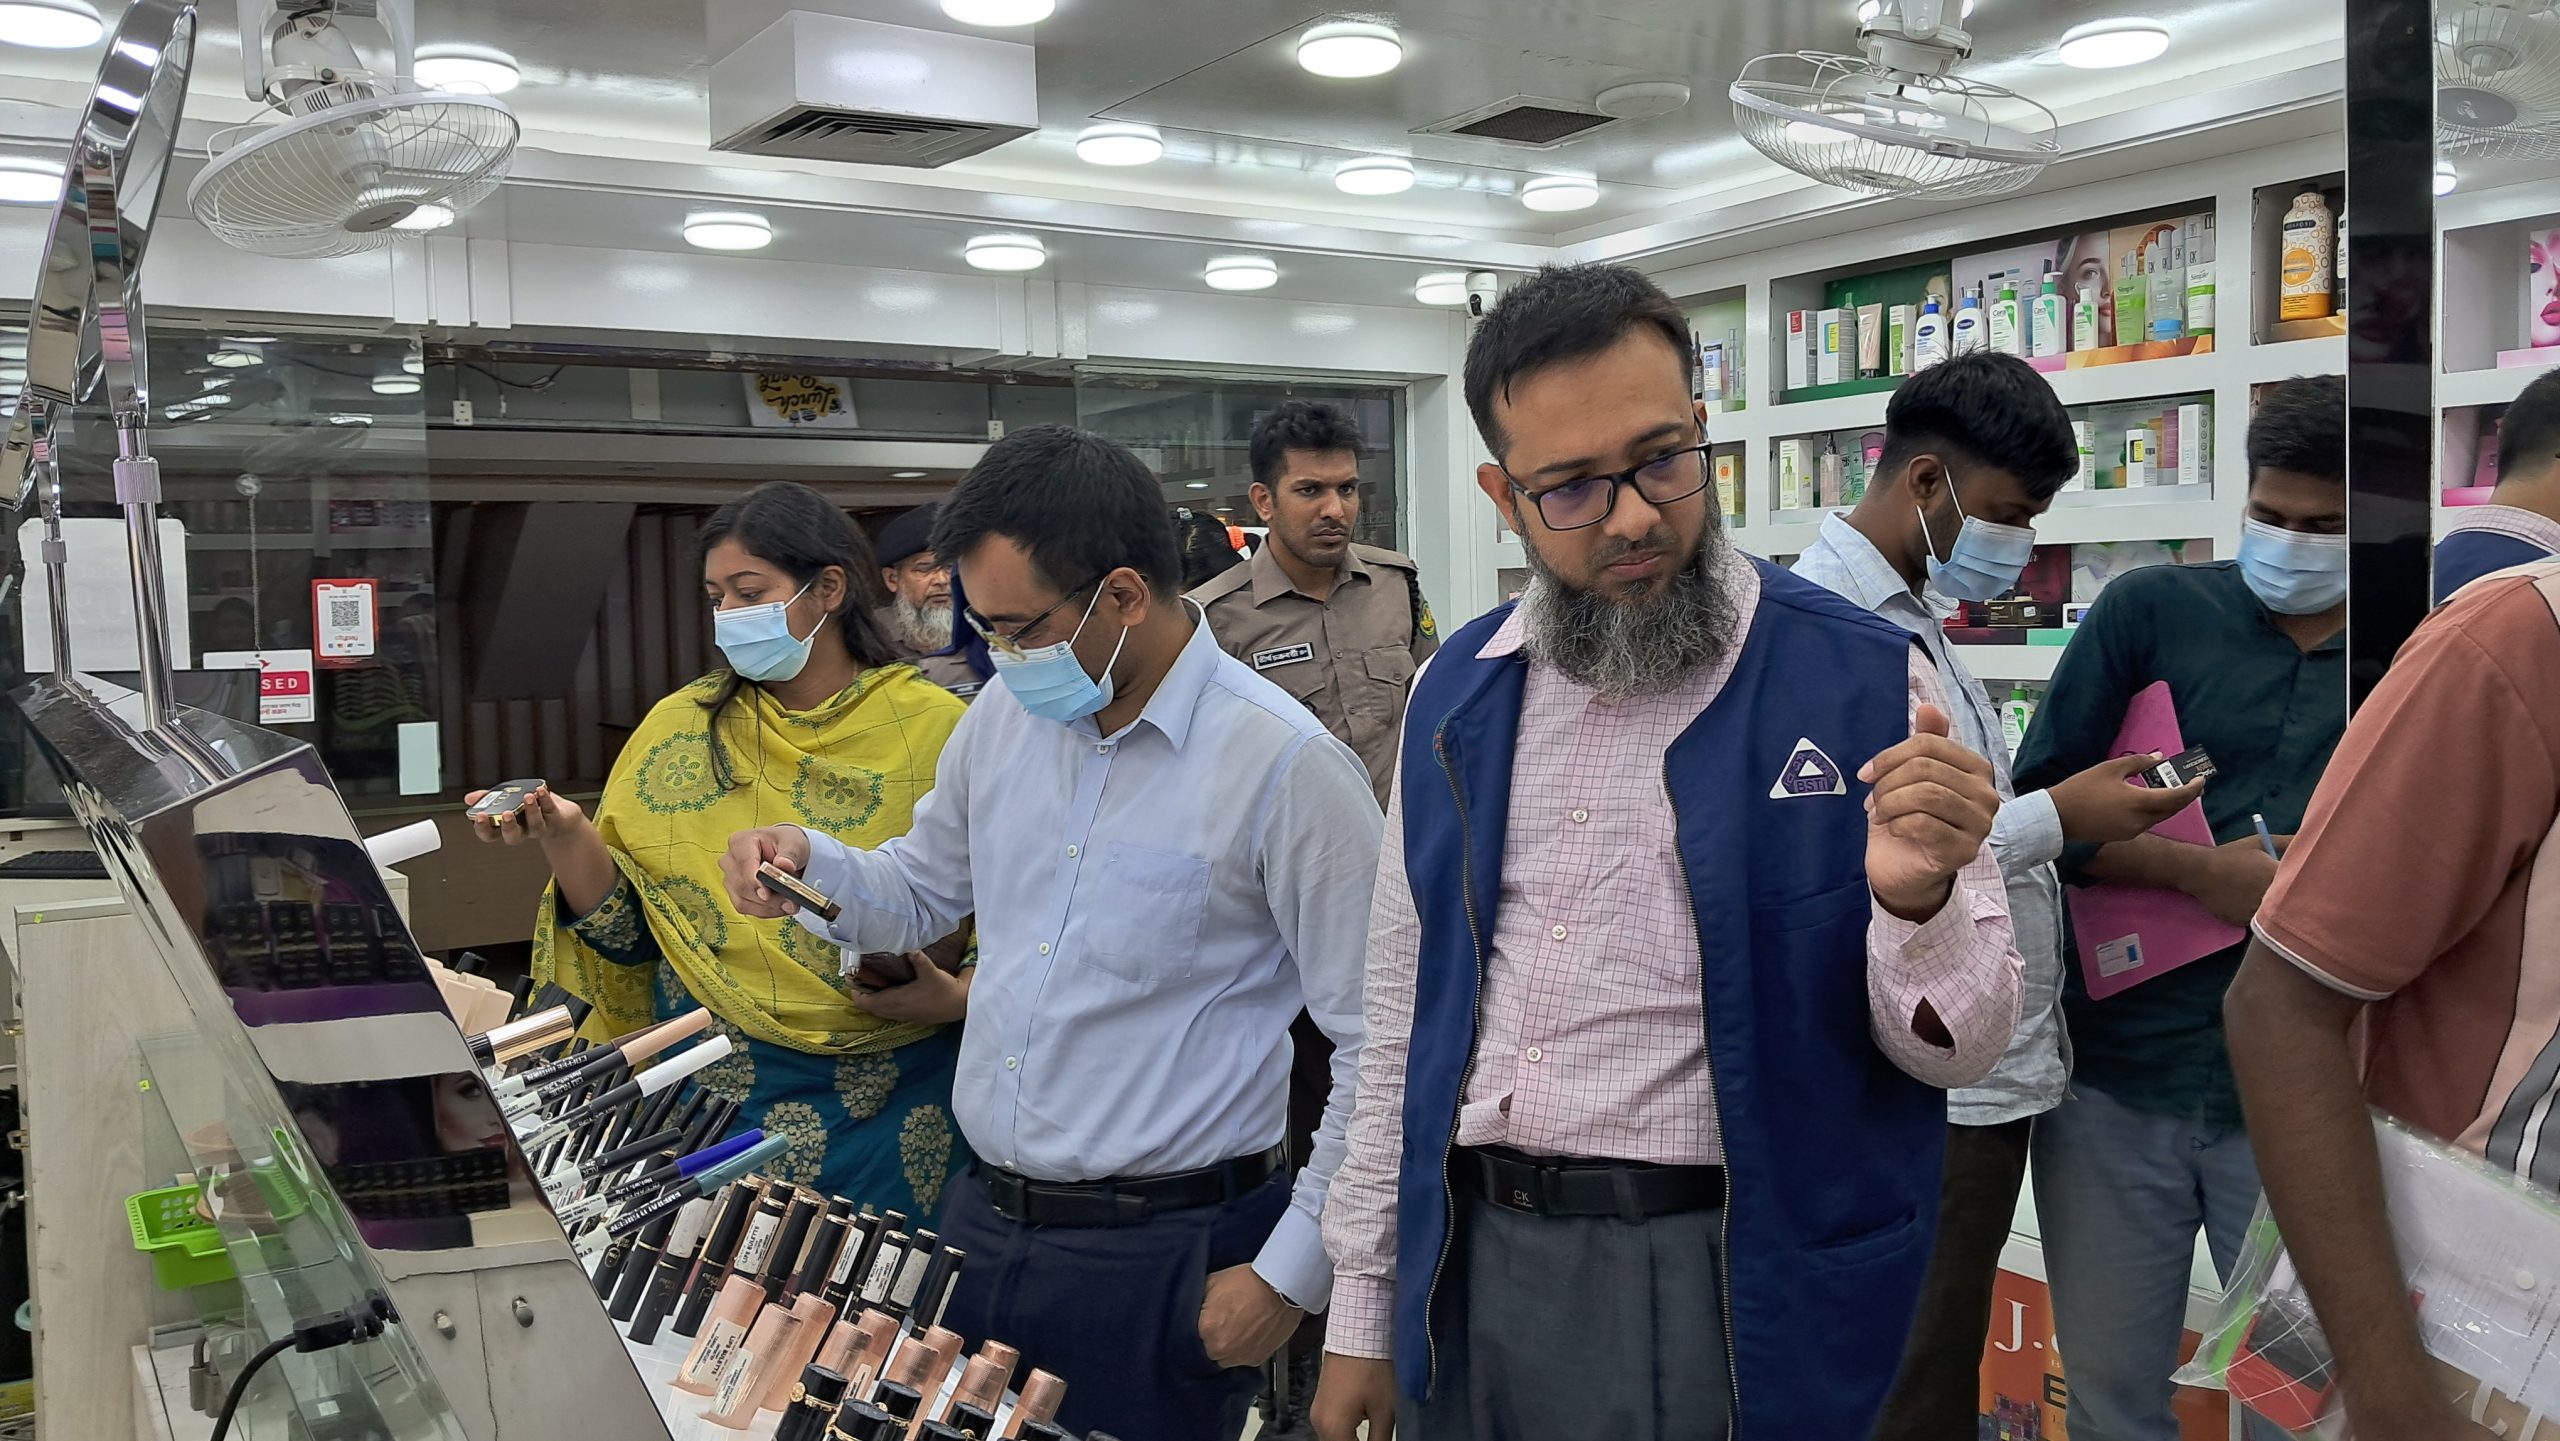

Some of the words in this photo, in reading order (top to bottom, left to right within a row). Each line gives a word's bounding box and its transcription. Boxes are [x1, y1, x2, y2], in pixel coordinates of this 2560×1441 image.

[767, 386, 836, 414] Lunch
[1796, 779, 1826, 792] BSTI
[1513, 1189, 1529, 1202] CK
